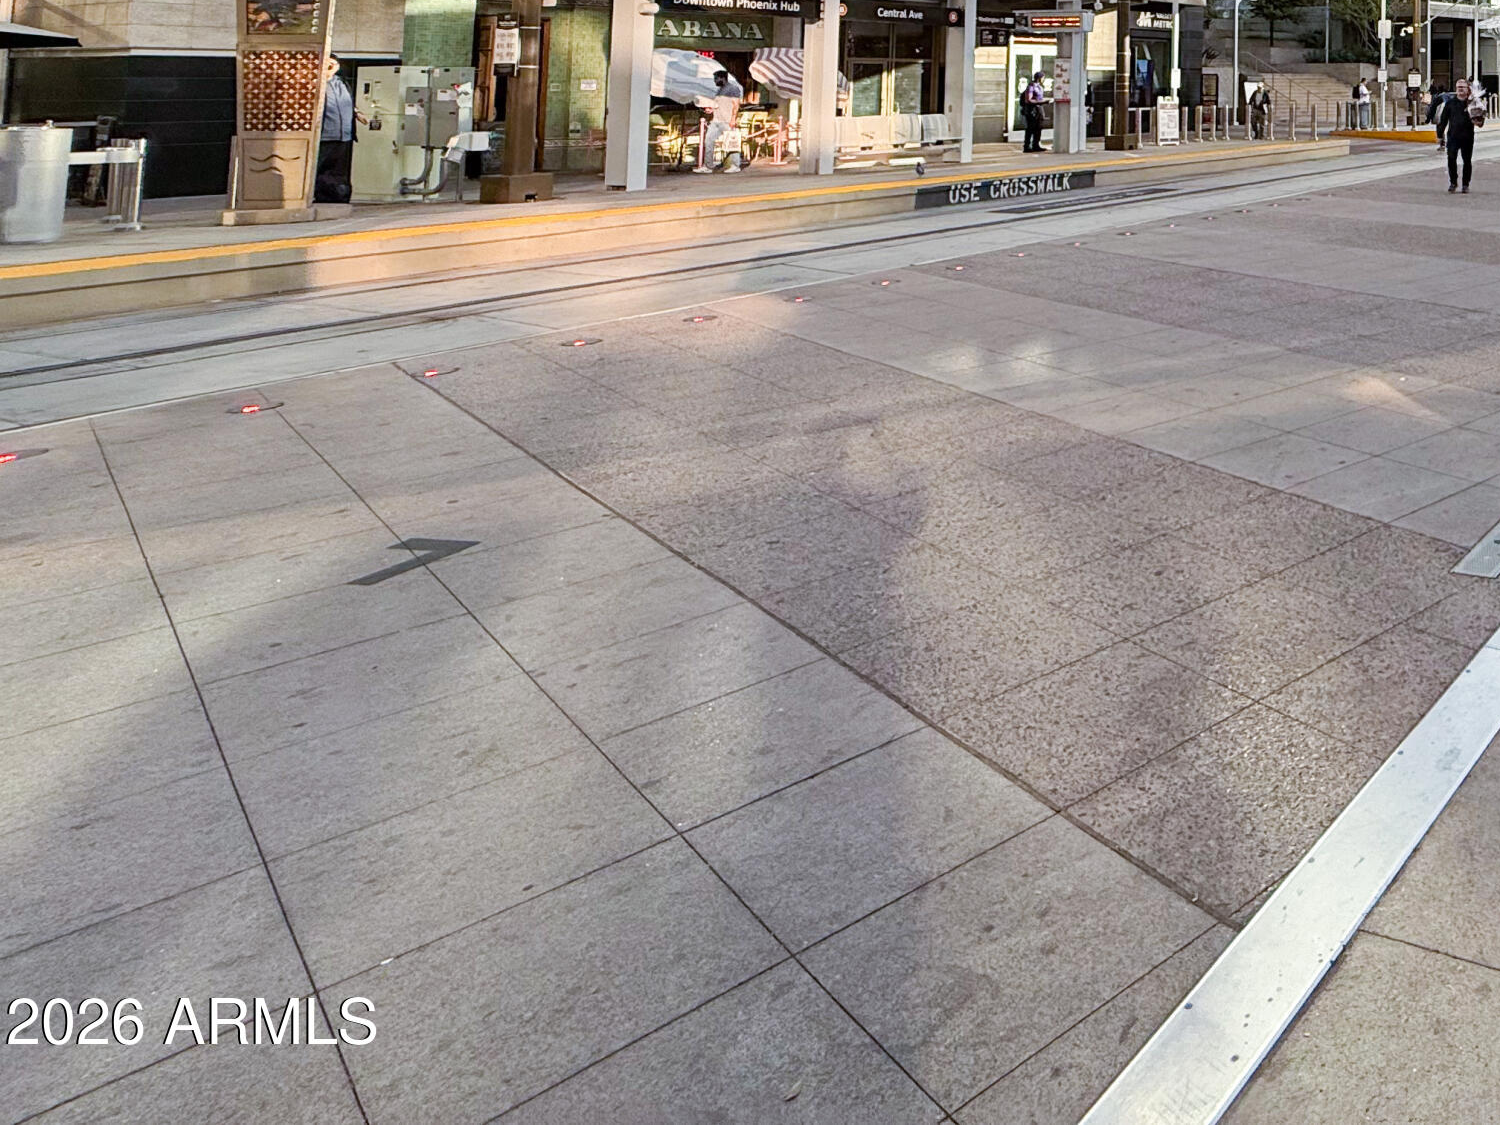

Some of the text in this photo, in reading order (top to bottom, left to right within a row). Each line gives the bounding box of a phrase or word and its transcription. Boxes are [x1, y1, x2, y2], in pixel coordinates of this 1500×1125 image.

[780, 1, 800, 12] Hub
[877, 7, 923, 20] Central Ave
[949, 173, 1072, 203] USE CROSSWALK
